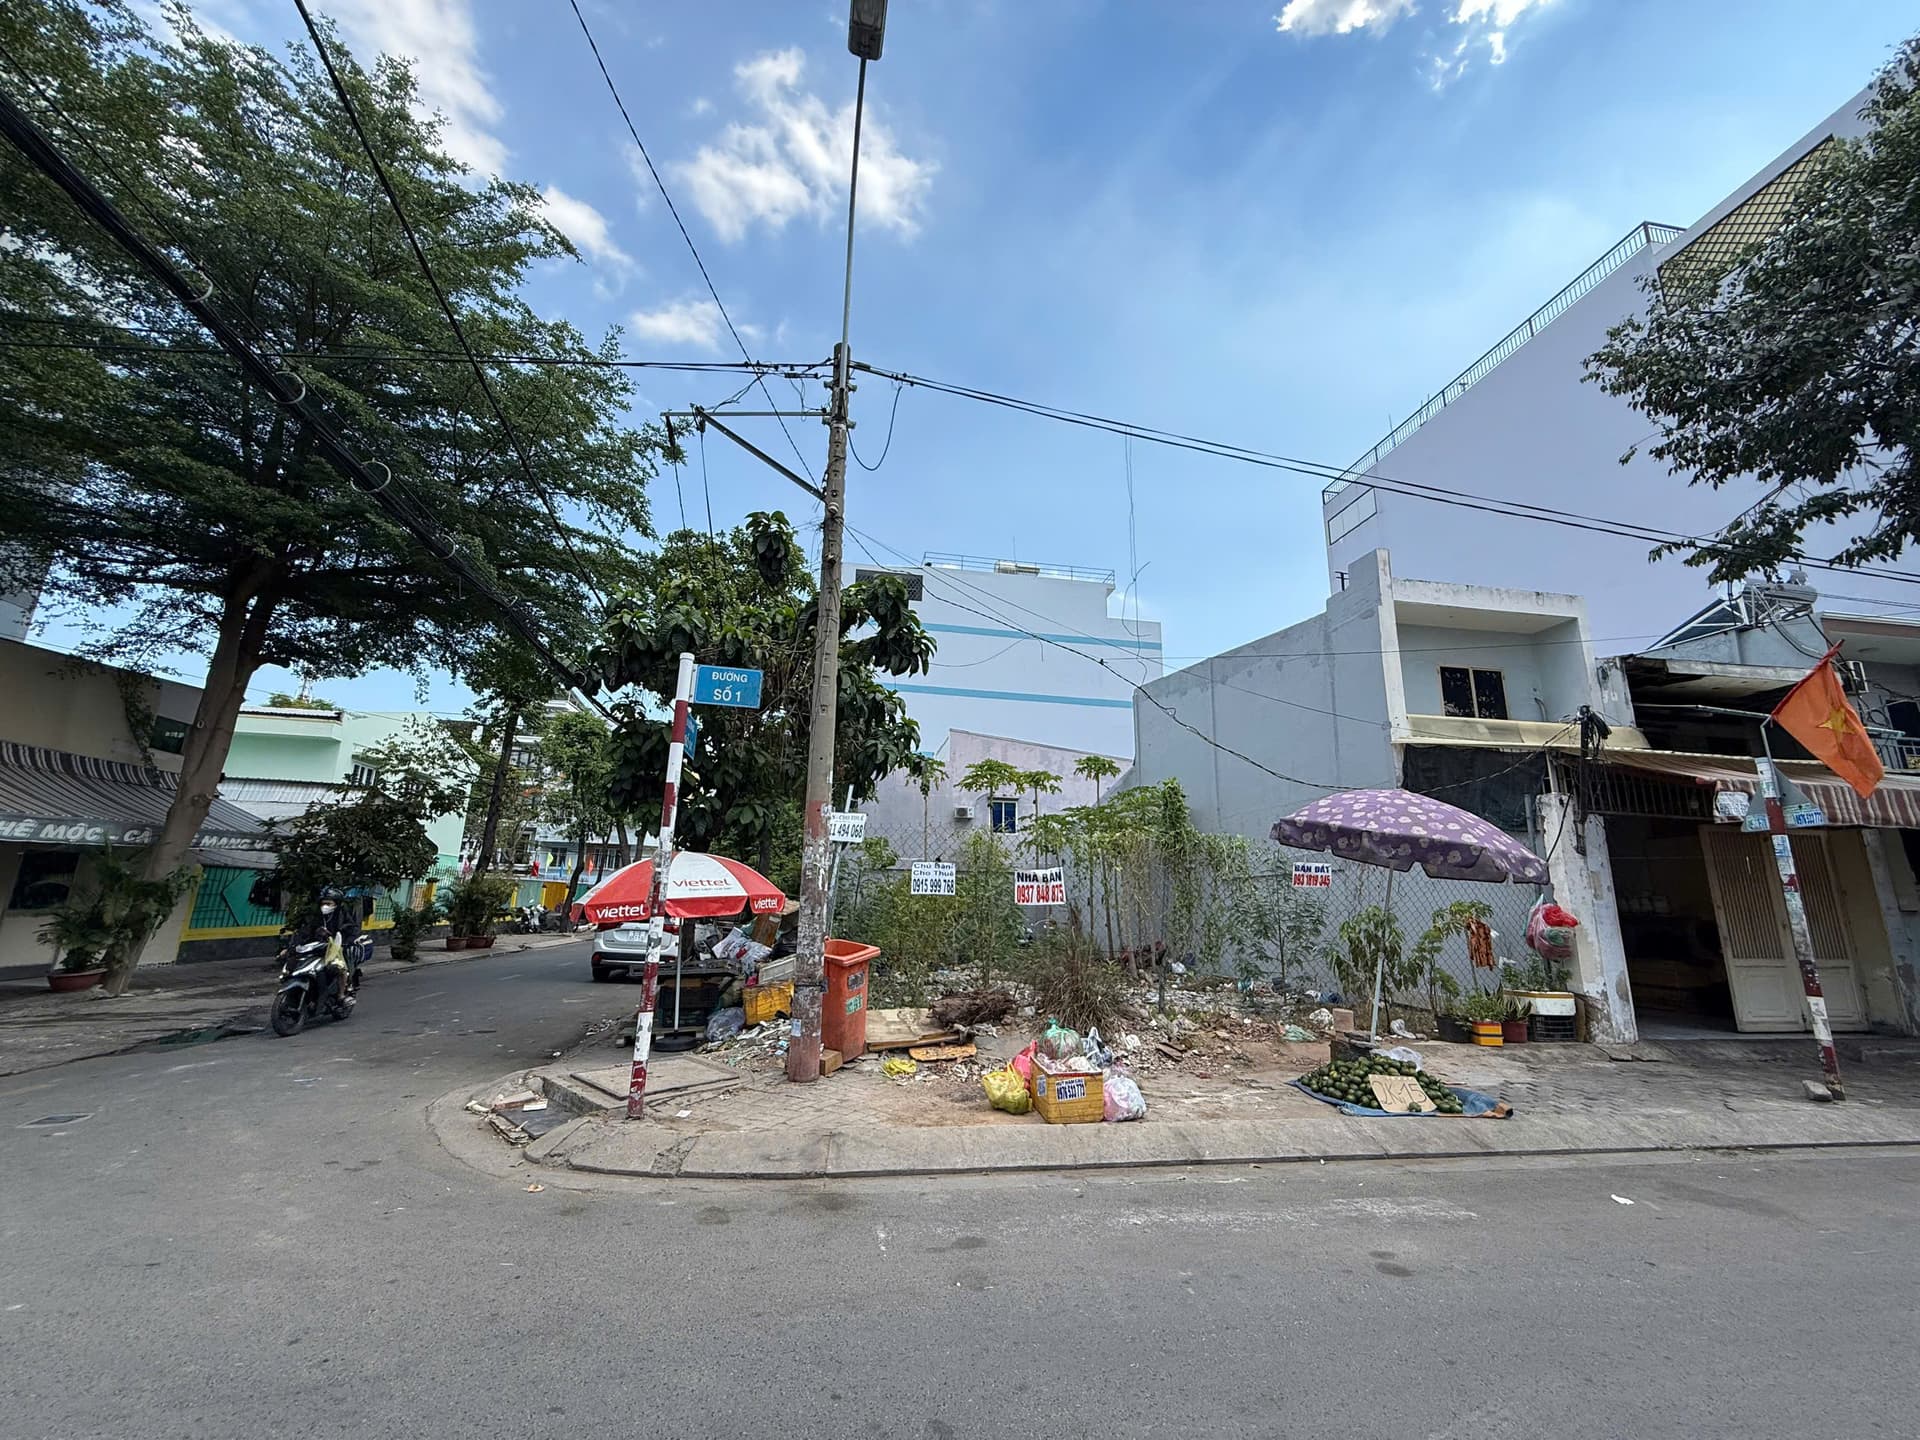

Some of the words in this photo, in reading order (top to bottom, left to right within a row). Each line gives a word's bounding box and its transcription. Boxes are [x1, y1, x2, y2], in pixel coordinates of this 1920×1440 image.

[712, 671, 748, 683] ĐƯỜNG
[713, 685, 732, 701] SỐ
[735, 691, 741, 702] 1
[39, 822, 104, 843] MỘC
[200, 834, 252, 850] MANG
[837, 823, 850, 837] 494
[850, 824, 864, 838] 068
[1294, 864, 1312, 873] BÁN
[673, 876, 732, 888] viettel
[1016, 871, 1039, 883] NHÀ
[1293, 874, 1305, 886] 093
[912, 878, 929, 893] 0915
[929, 878, 942, 893] 999
[942, 879, 954, 894] 768
[1016, 884, 1034, 904] 0937
[1036, 884, 1049, 904] 848
[1051, 884, 1064, 903] 875
[753, 897, 779, 909] viettel
[596, 902, 646, 920] viettel
